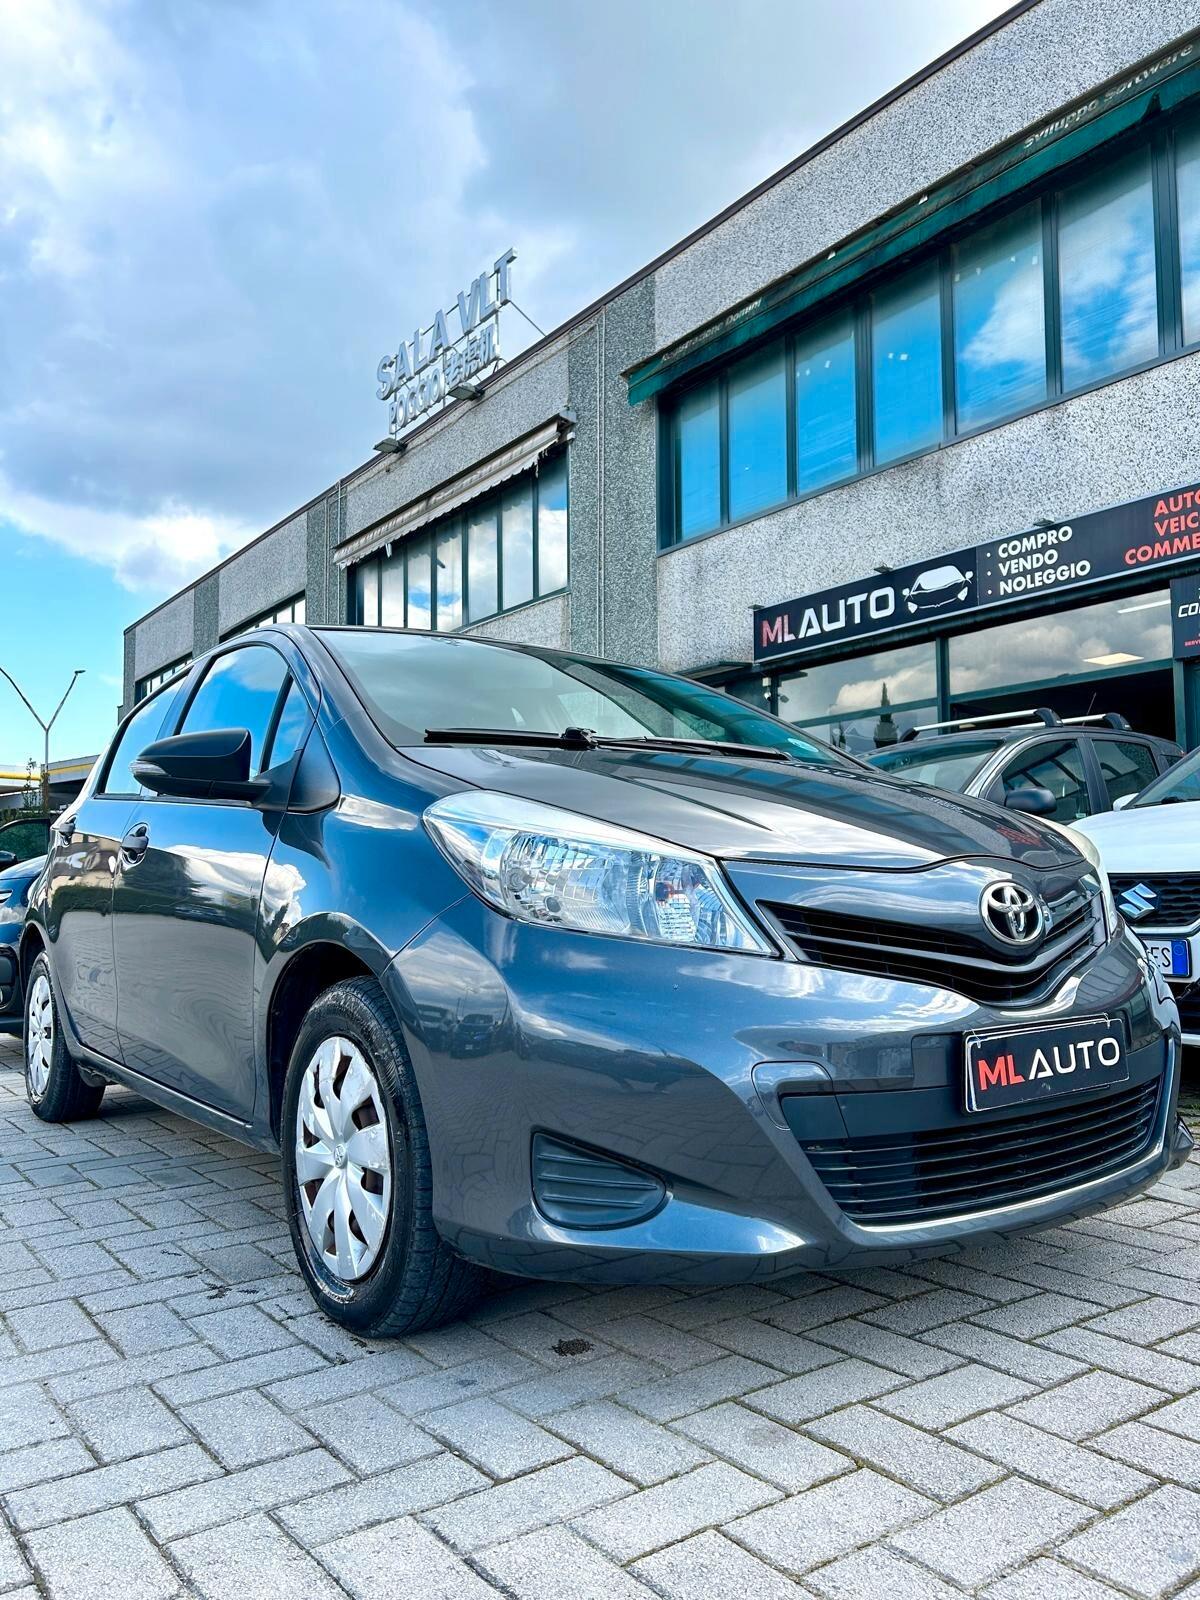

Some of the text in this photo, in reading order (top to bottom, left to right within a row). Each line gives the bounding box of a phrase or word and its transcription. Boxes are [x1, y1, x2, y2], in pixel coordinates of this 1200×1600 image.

[376, 246, 518, 400] SALA VLT
[389, 368, 445, 435] POGGIO
[998, 526, 1073, 559] COMPRO
[998, 550, 1058, 577] VENDO
[1125, 532, 1200, 565] COMME
[998, 560, 1091, 596] NOLEGGIO
[761, 586, 896, 648] ML AUTO
[977, 1037, 1120, 1091] ML AUTO
